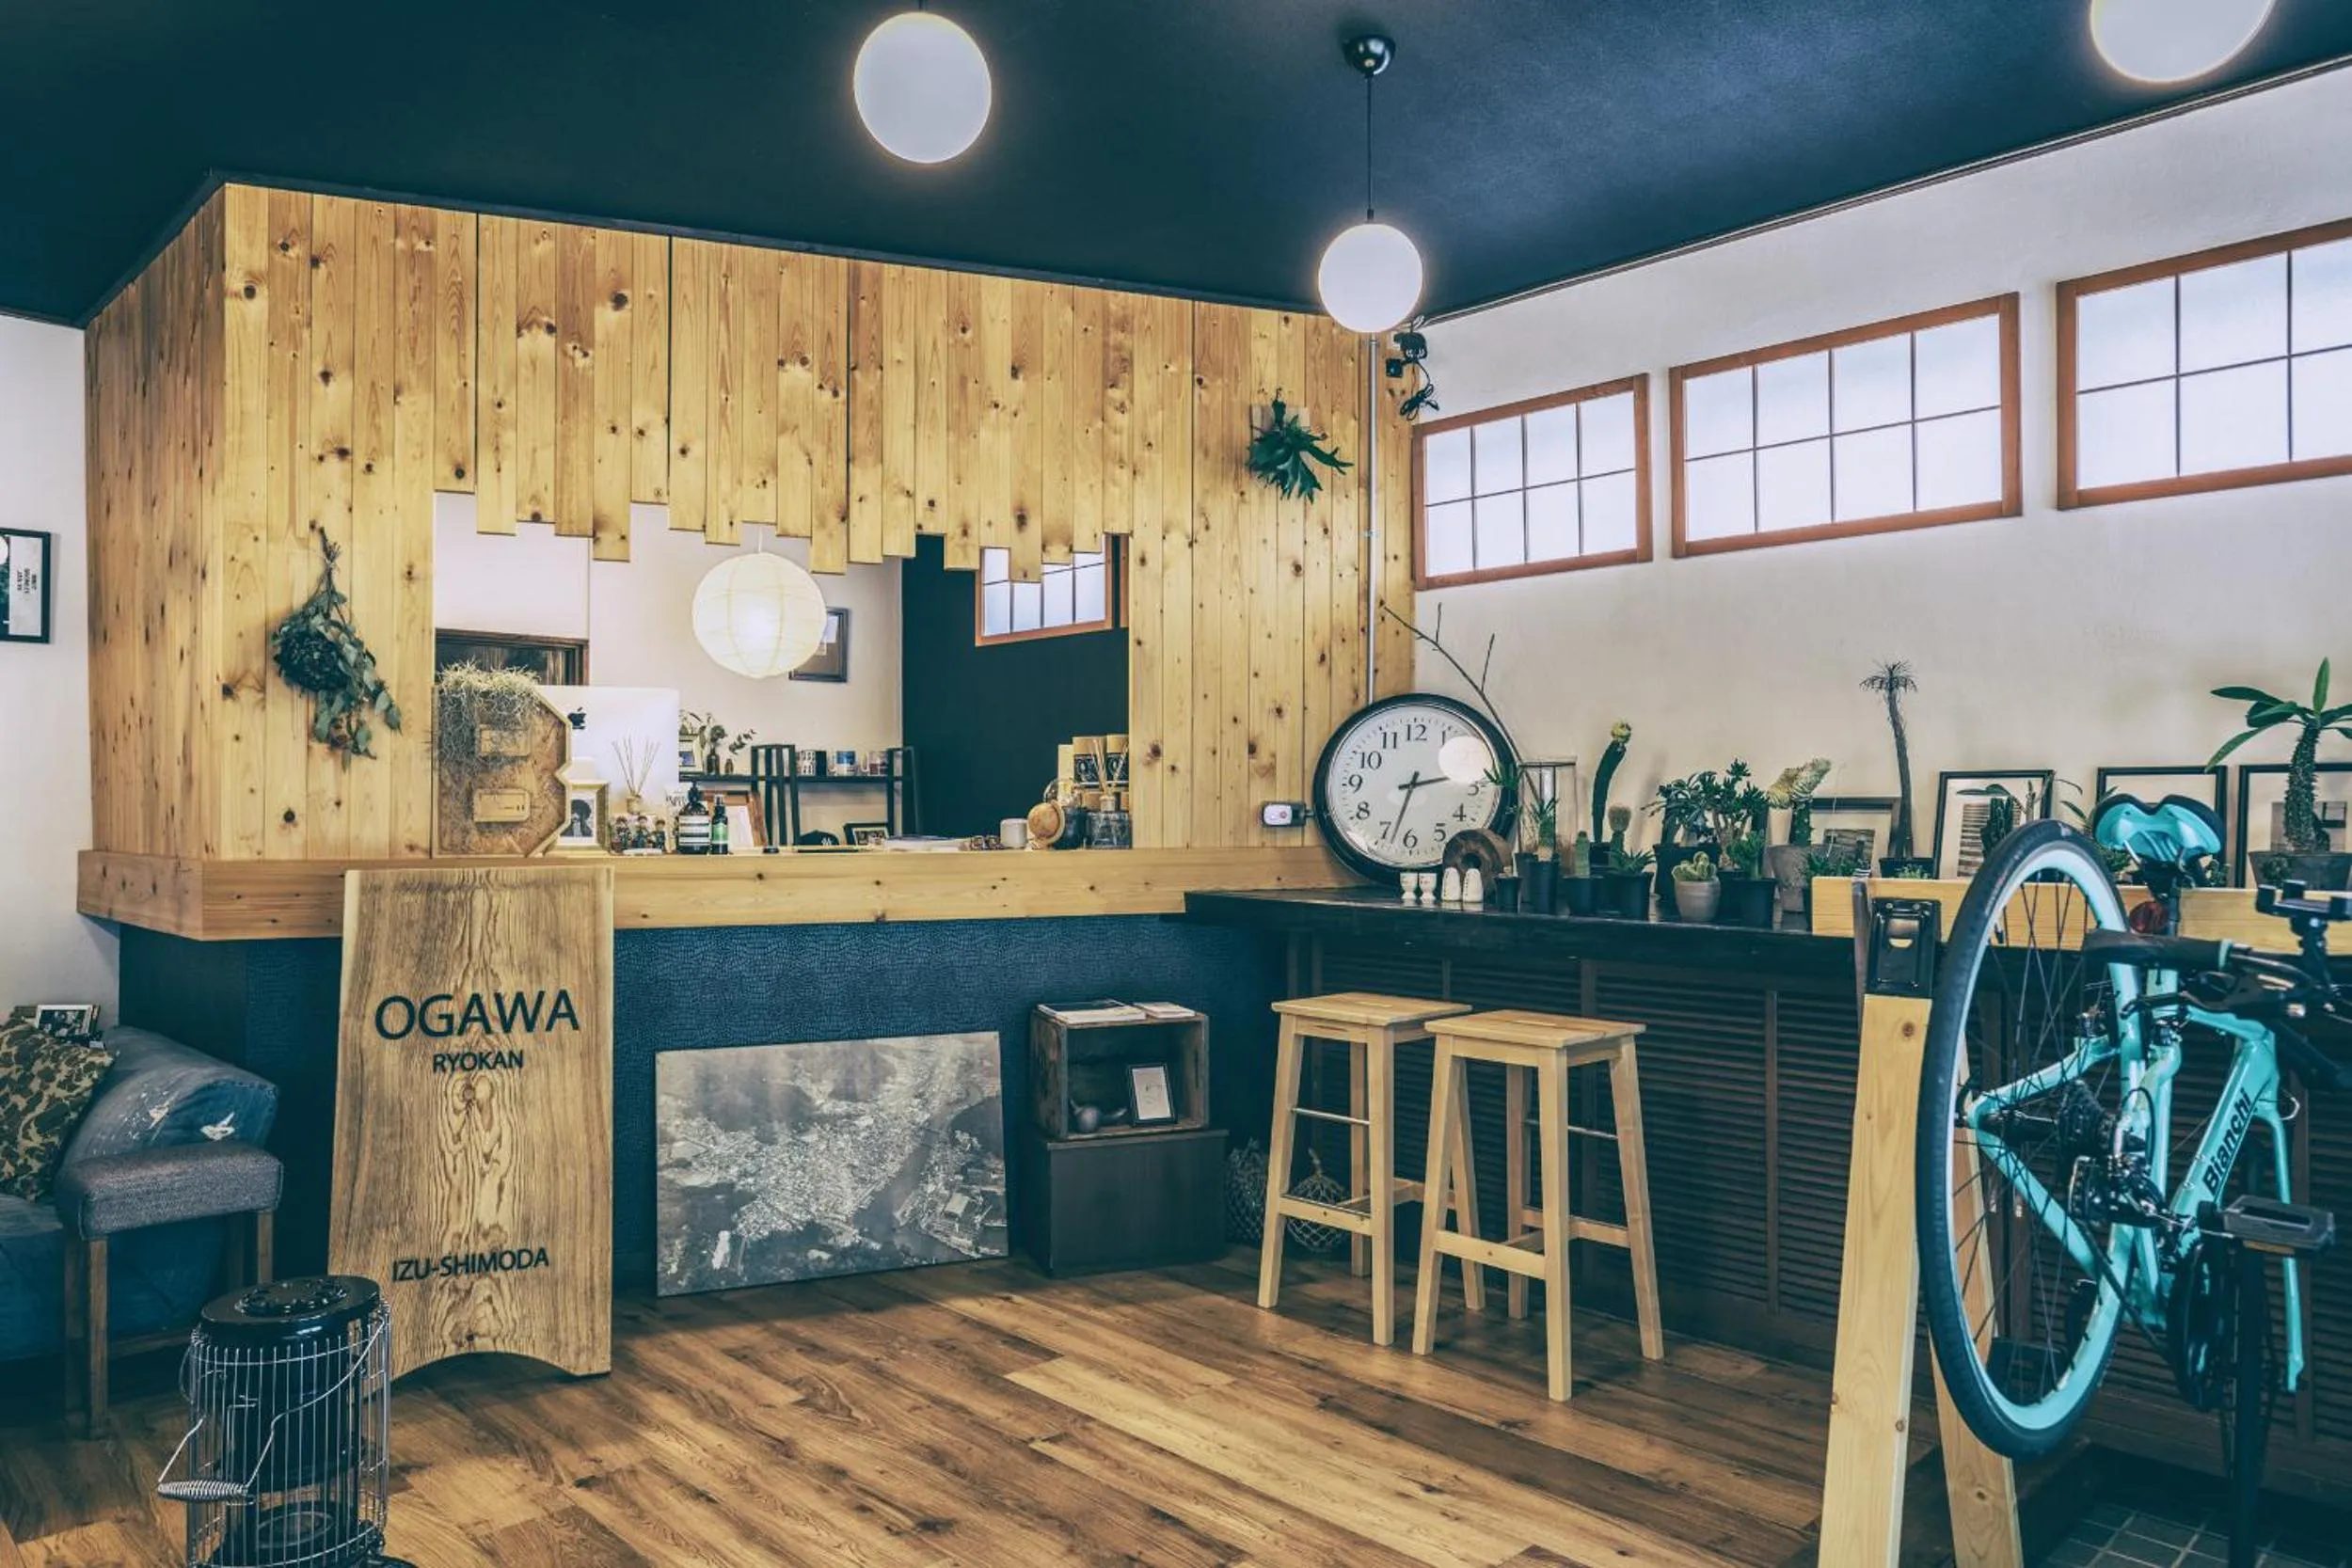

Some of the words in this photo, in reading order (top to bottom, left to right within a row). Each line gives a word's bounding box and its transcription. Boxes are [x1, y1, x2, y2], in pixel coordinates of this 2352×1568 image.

[1381, 731, 1398, 750] 11
[1406, 723, 1427, 741] 12
[1359, 751, 1382, 769] 10
[1349, 774, 1363, 793] 9
[1356, 801, 1371, 820] 8
[1453, 803, 1467, 822] 4
[1379, 821, 1391, 840] 7
[1403, 828, 1418, 848] 6
[1434, 823, 1446, 842] 5
[374, 990, 580, 1040] OGAWA
[433, 1049, 524, 1074] RYOKAN
[2202, 1087, 2253, 1196] Bianchi
[391, 1246, 549, 1282] IZU-SHIMODA
